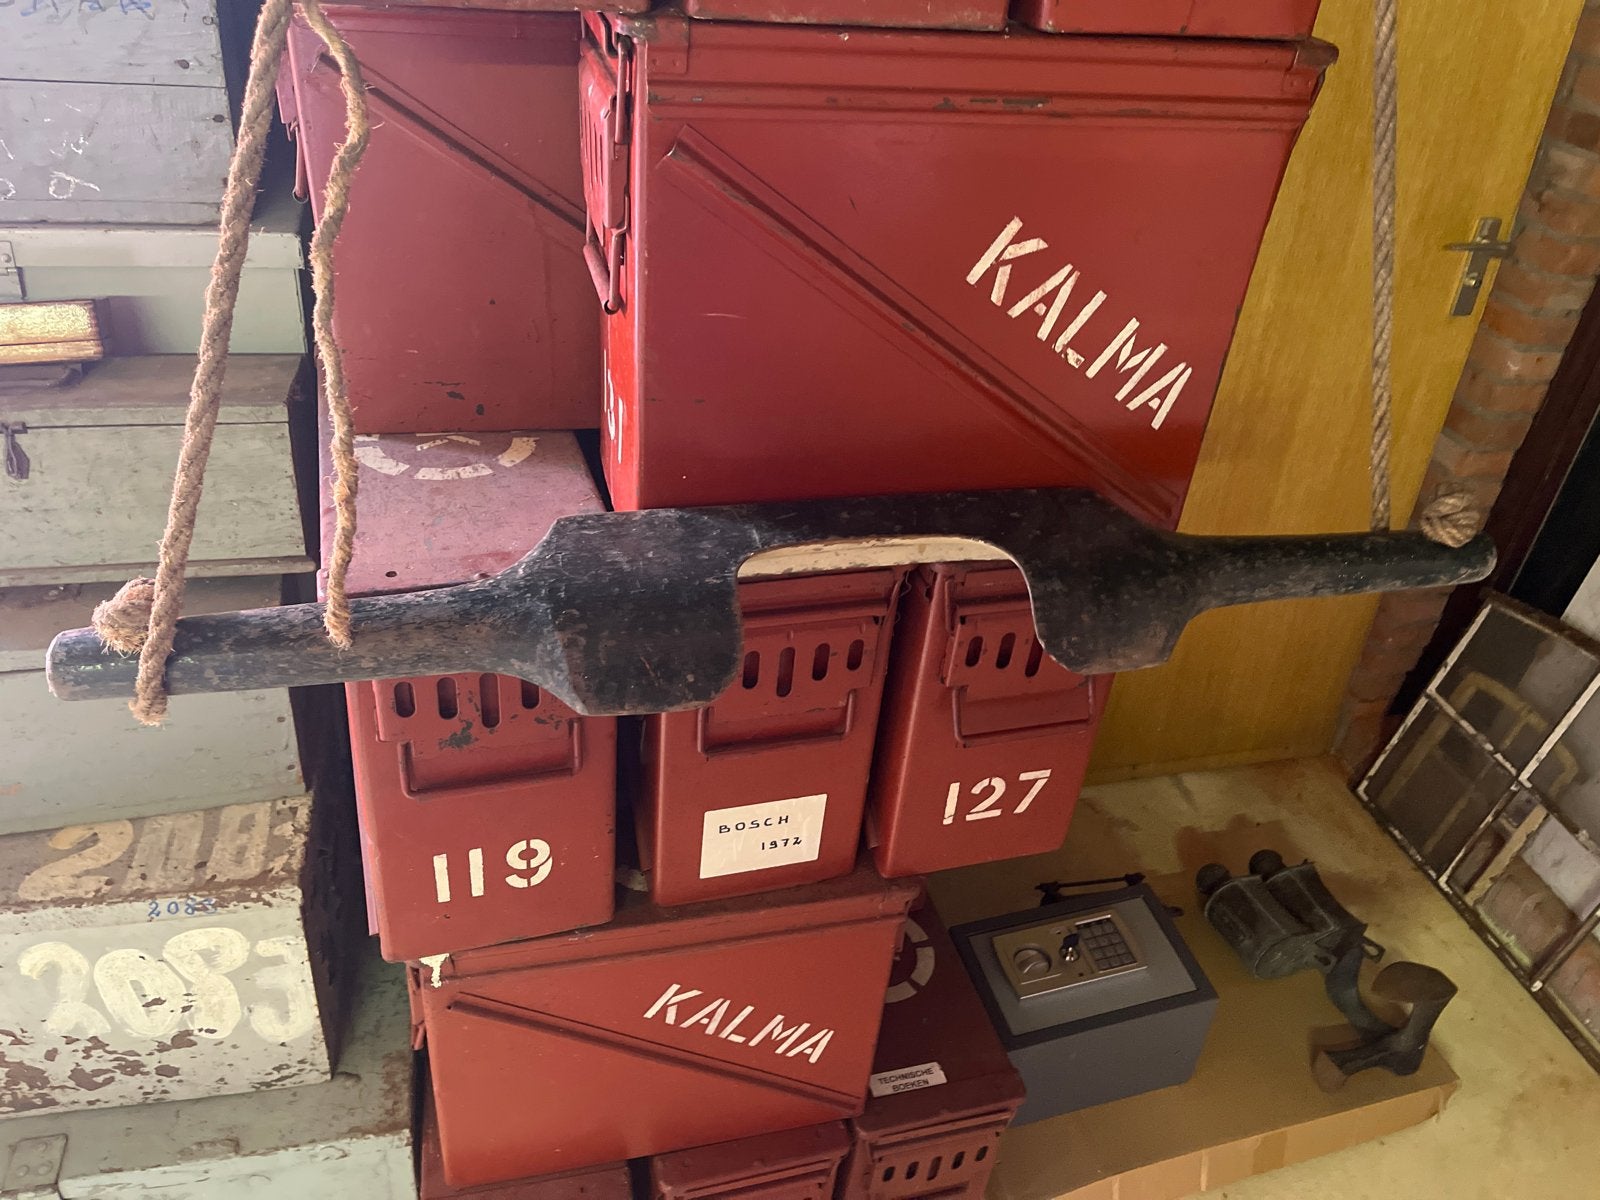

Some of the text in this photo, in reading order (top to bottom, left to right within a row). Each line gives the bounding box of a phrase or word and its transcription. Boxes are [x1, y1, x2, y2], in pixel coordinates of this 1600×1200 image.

[965, 215, 1193, 431] KALMA
[718, 815, 790, 834] BOSCH
[942, 768, 1053, 826] 127
[432, 838, 553, 903] 119
[760, 836, 803, 851] 1972
[17, 927, 317, 1044] 2083
[642, 983, 835, 1064] KALMA
[877, 1067, 935, 1085] TECHNISCHE
[891, 1078, 930, 1093] BOEKEN
